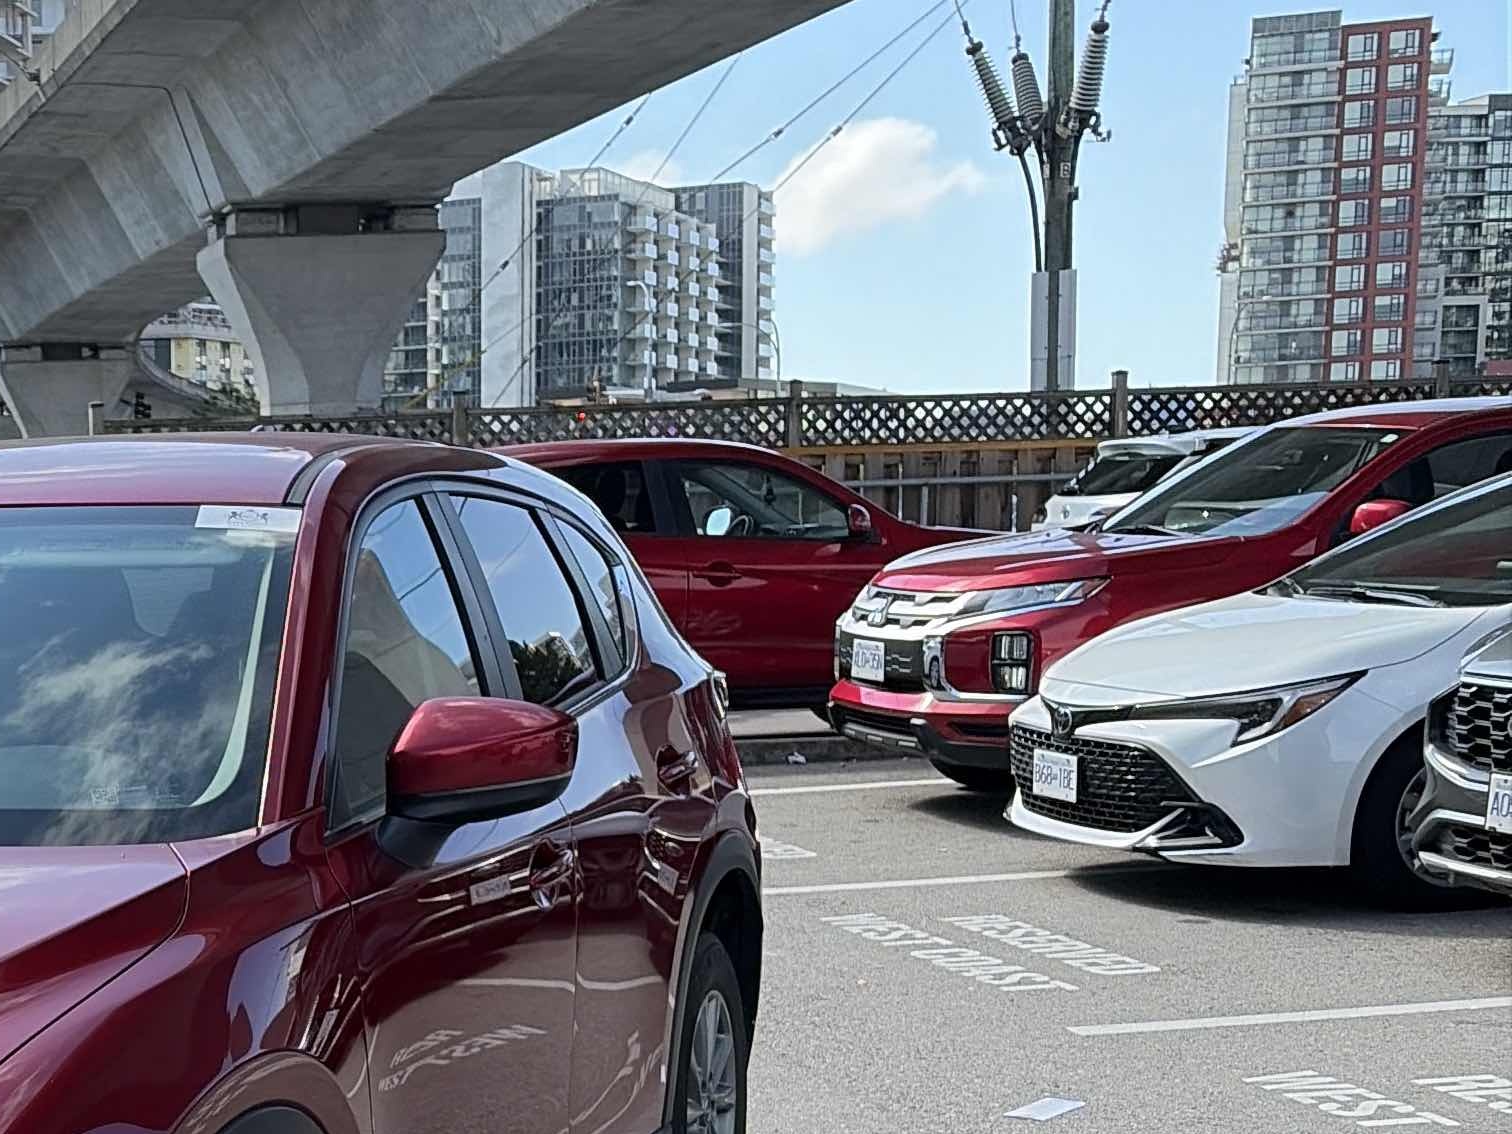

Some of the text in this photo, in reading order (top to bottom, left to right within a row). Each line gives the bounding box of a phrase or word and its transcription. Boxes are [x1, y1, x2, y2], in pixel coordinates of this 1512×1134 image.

[819, 912, 1080, 992] WEST COAST
[939, 913, 1162, 976] RESERVED
[1241, 1069, 1461, 1127] WEST
